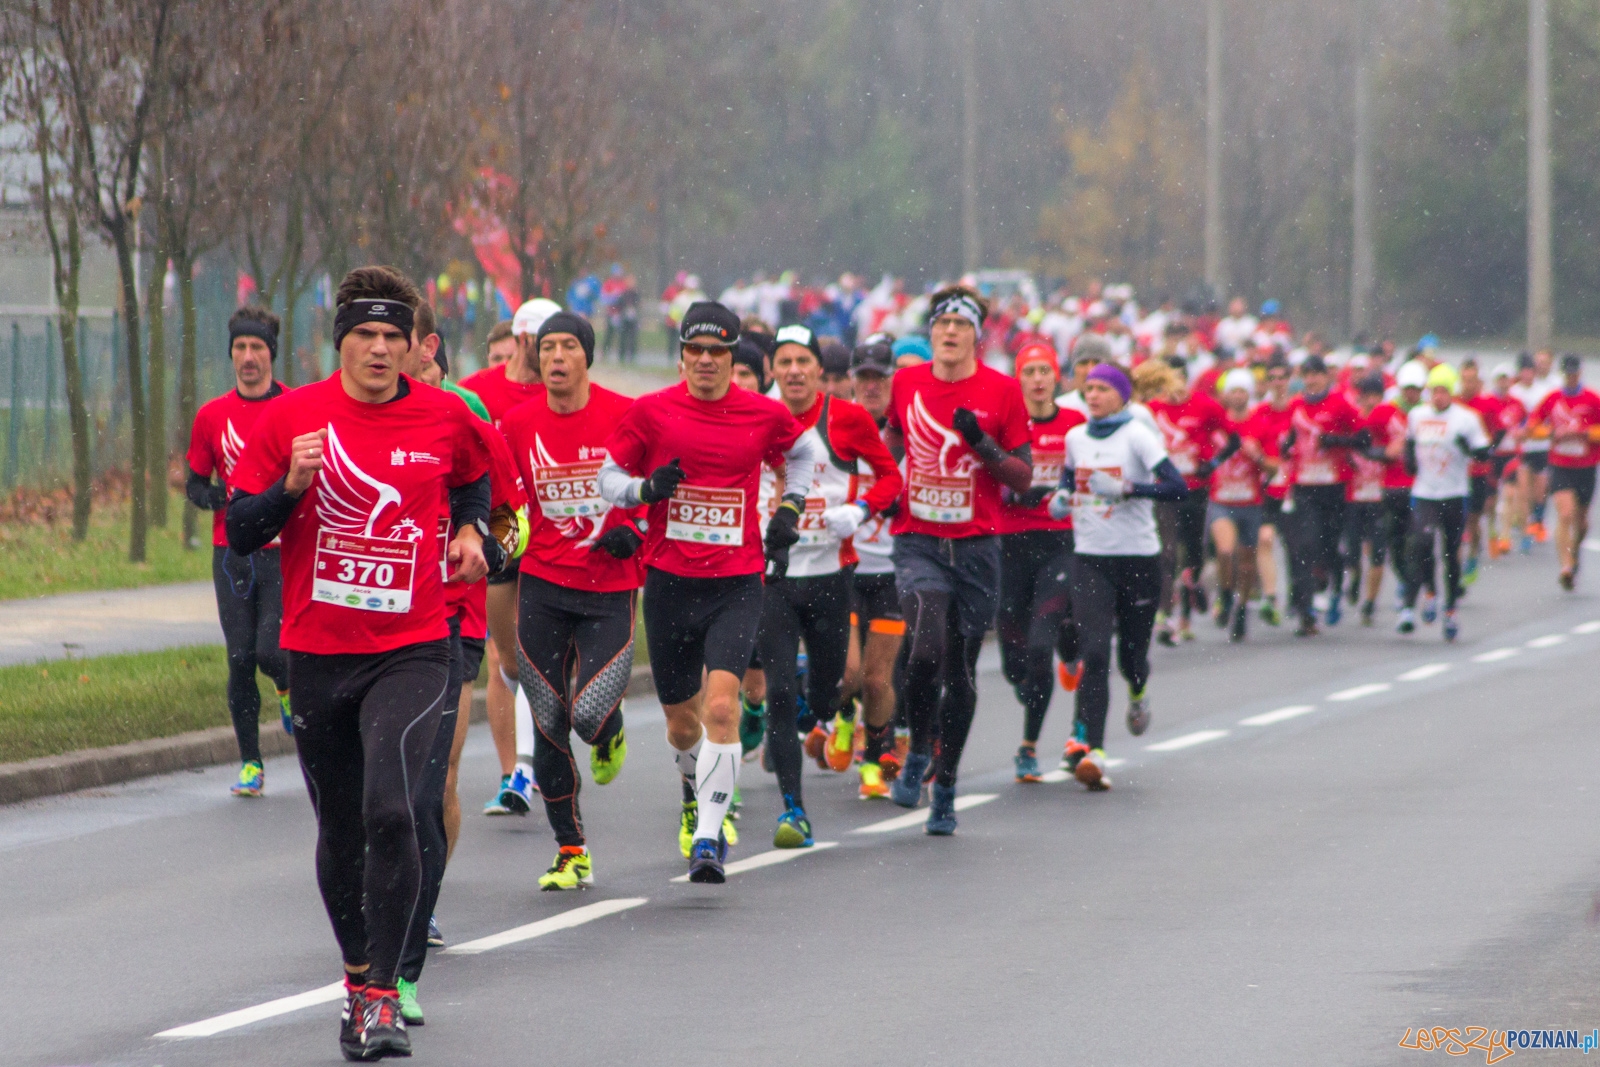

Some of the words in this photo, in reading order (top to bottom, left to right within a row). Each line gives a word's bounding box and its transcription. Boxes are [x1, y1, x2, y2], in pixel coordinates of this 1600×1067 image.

[546, 480, 600, 500] 6253
[917, 487, 965, 507] 4059
[679, 504, 736, 526] 9294
[336, 558, 394, 587] 370
